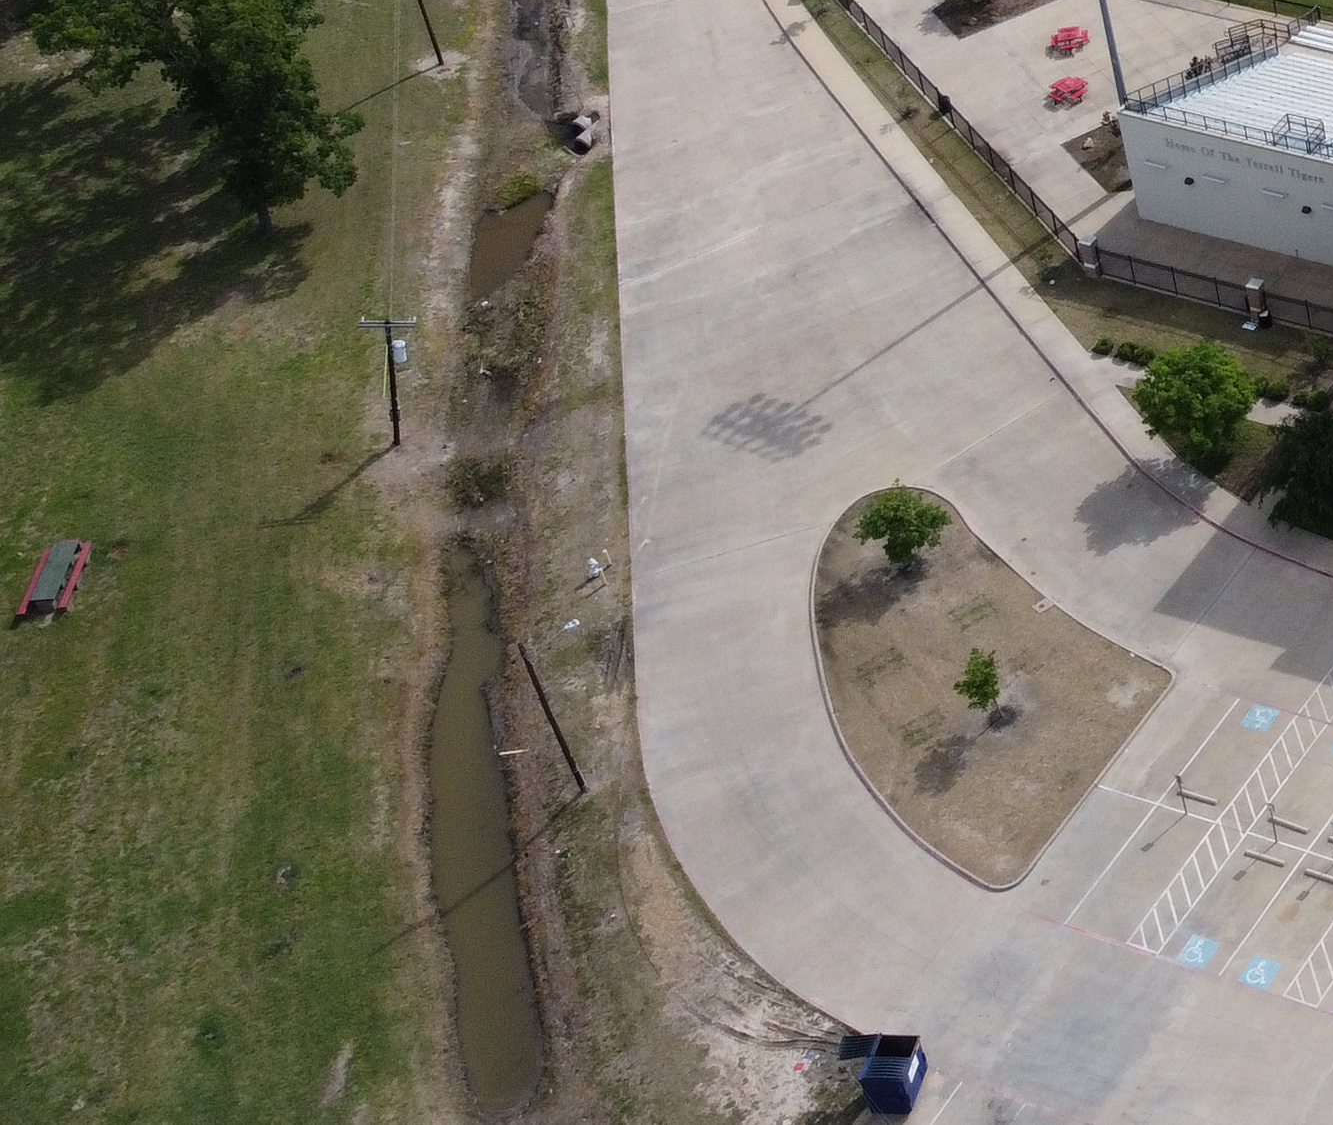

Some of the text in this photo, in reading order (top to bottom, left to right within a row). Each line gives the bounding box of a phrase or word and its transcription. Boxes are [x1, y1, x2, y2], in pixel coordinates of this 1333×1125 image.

[1165, 137, 1325, 184] Home Of The Terrell Tigers
